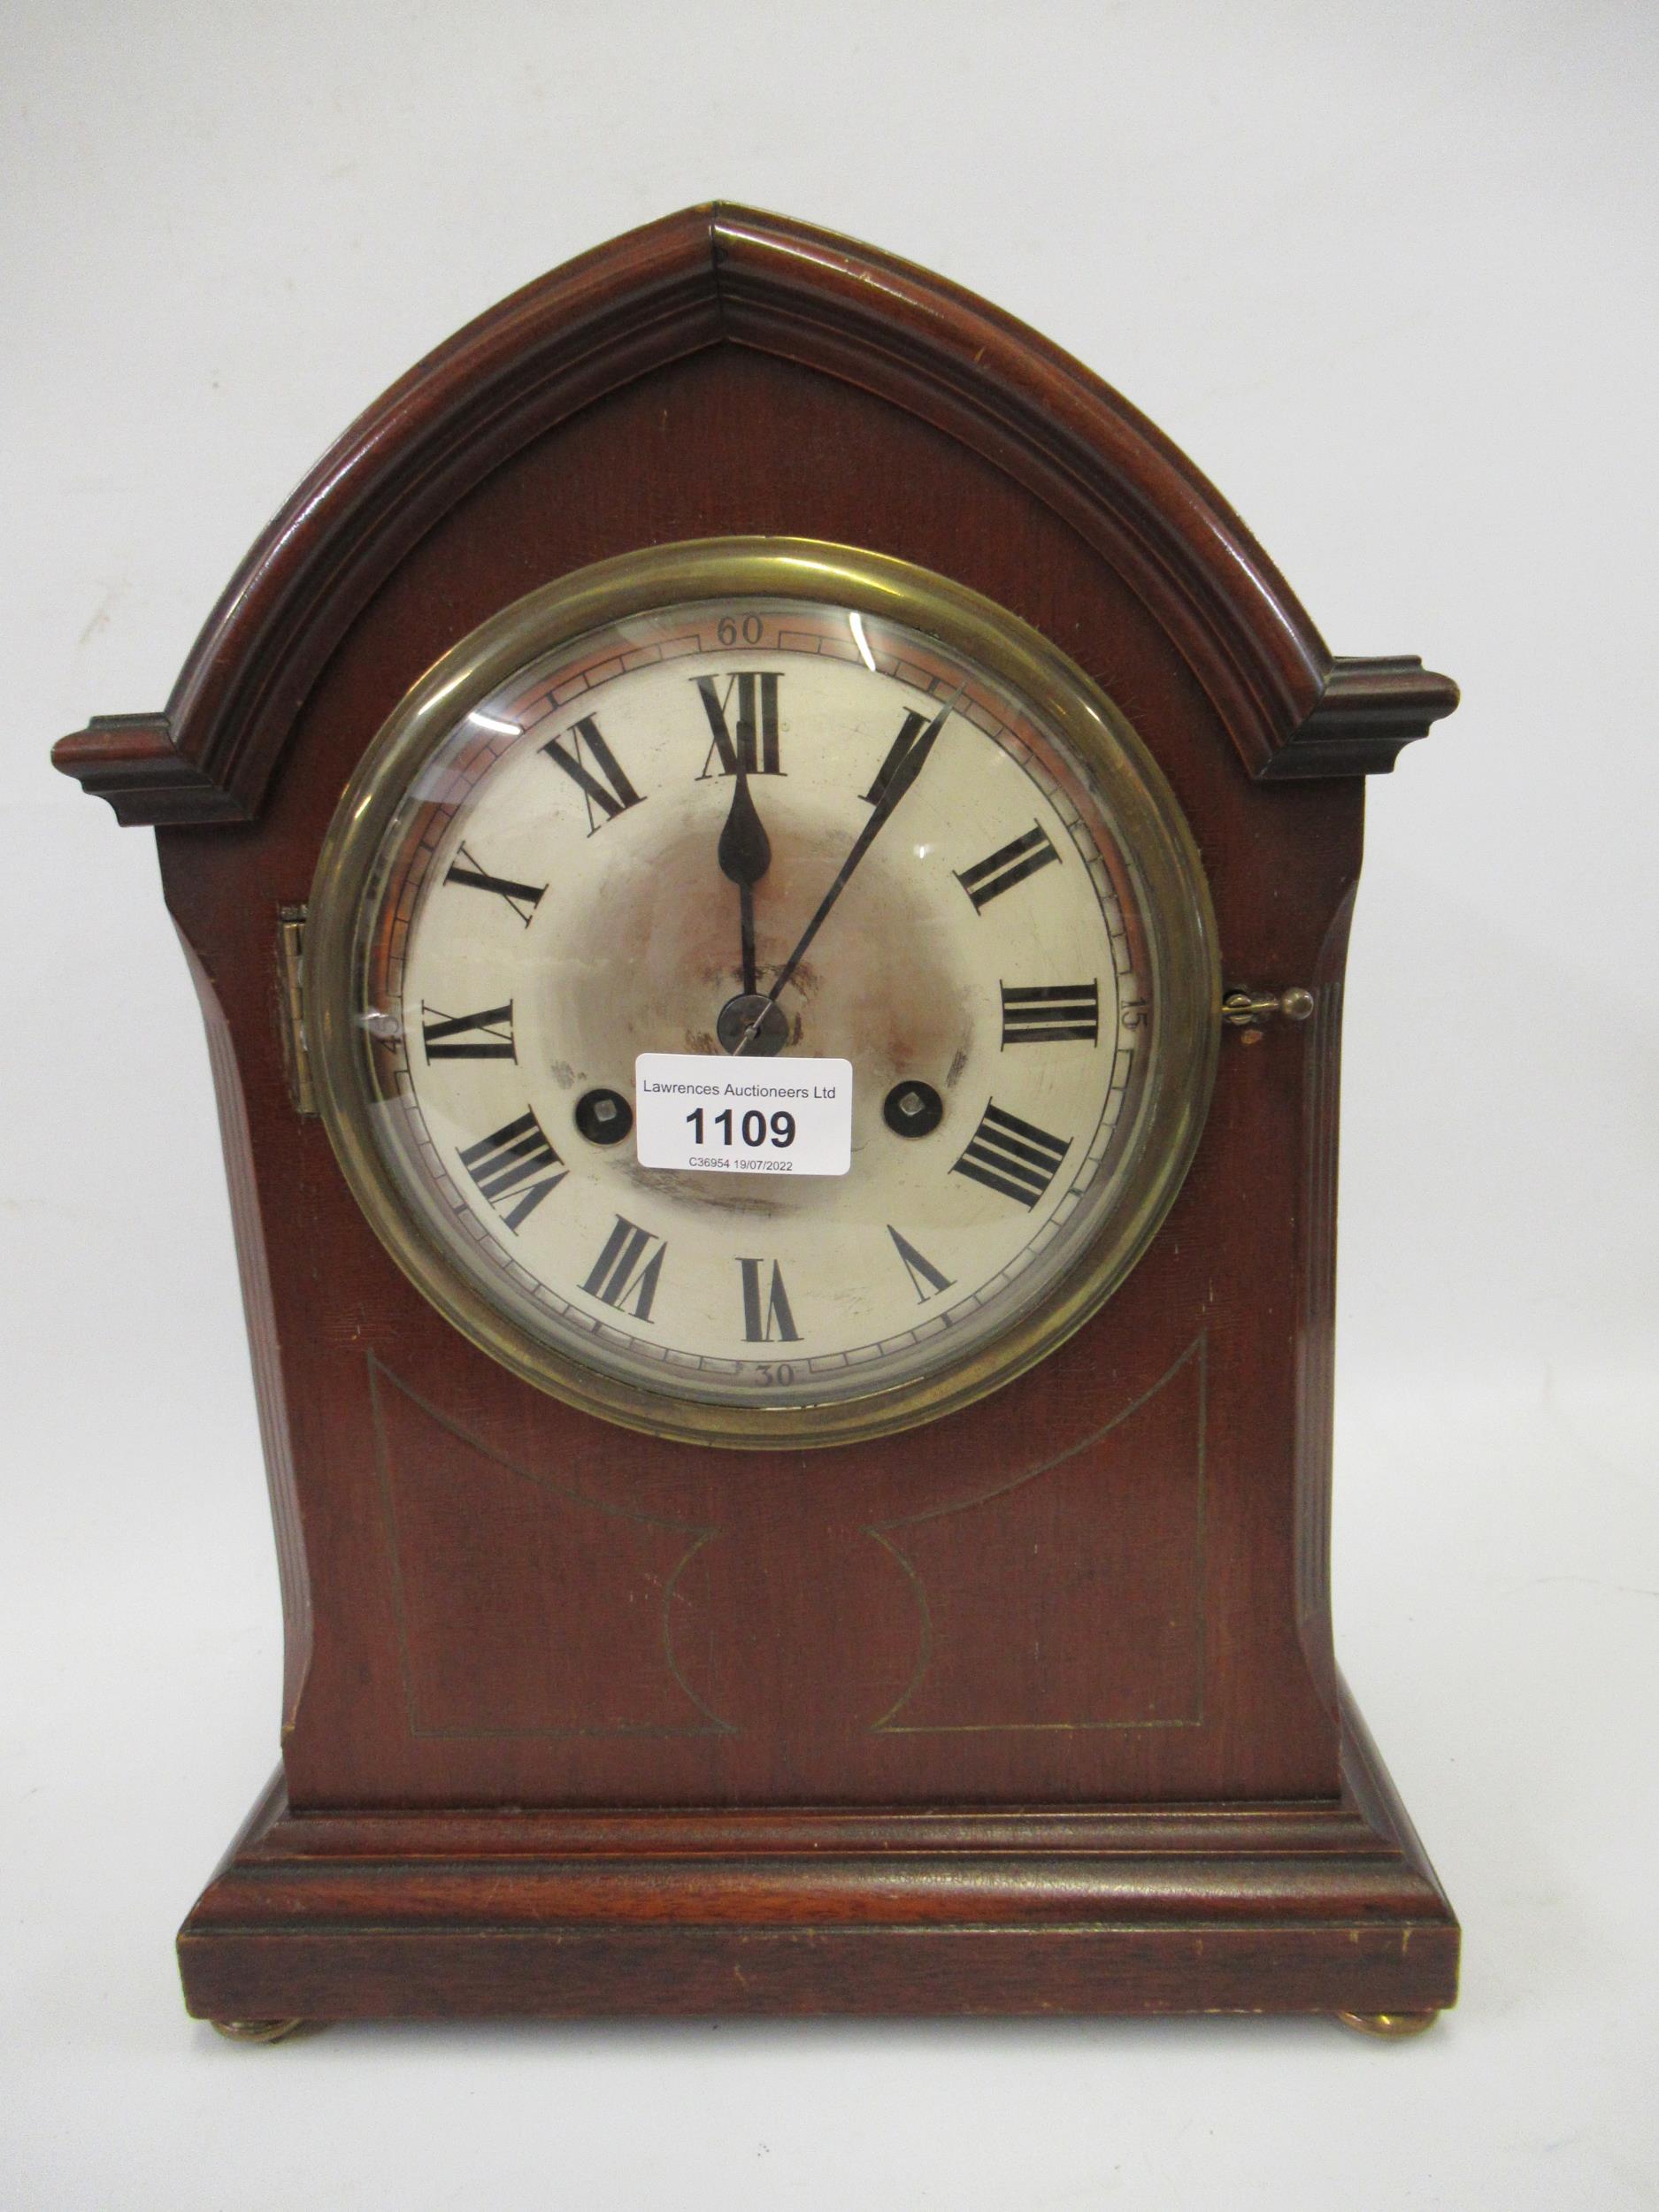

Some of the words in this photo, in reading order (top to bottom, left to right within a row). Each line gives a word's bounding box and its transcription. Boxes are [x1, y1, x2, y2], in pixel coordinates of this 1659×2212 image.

[717, 616, 764, 646] 60
[689, 672, 789, 780] XII
[536, 711, 648, 838] XI
[442, 841, 549, 928] X
[952, 818, 1064, 917] II
[421, 998, 518, 1065] IX
[999, 978, 1099, 1052] III
[1120, 997, 1148, 1032] 15
[642, 1079, 720, 1095] Lawrences
[724, 1083, 809, 1099] Auctioneers
[813, 1086, 836, 1099] Ltd
[686, 1107, 796, 1148] 1109
[455, 1104, 569, 1237] VIII
[688, 1156, 730, 1169] C36954
[733, 1159, 794, 1171] 19/07/2022
[947, 1095, 1074, 1213] IIII
[577, 1214, 668, 1325] VII
[734, 1256, 805, 1343] VI
[887, 1224, 957, 1306] V
[756, 1363, 795, 1387] 30
